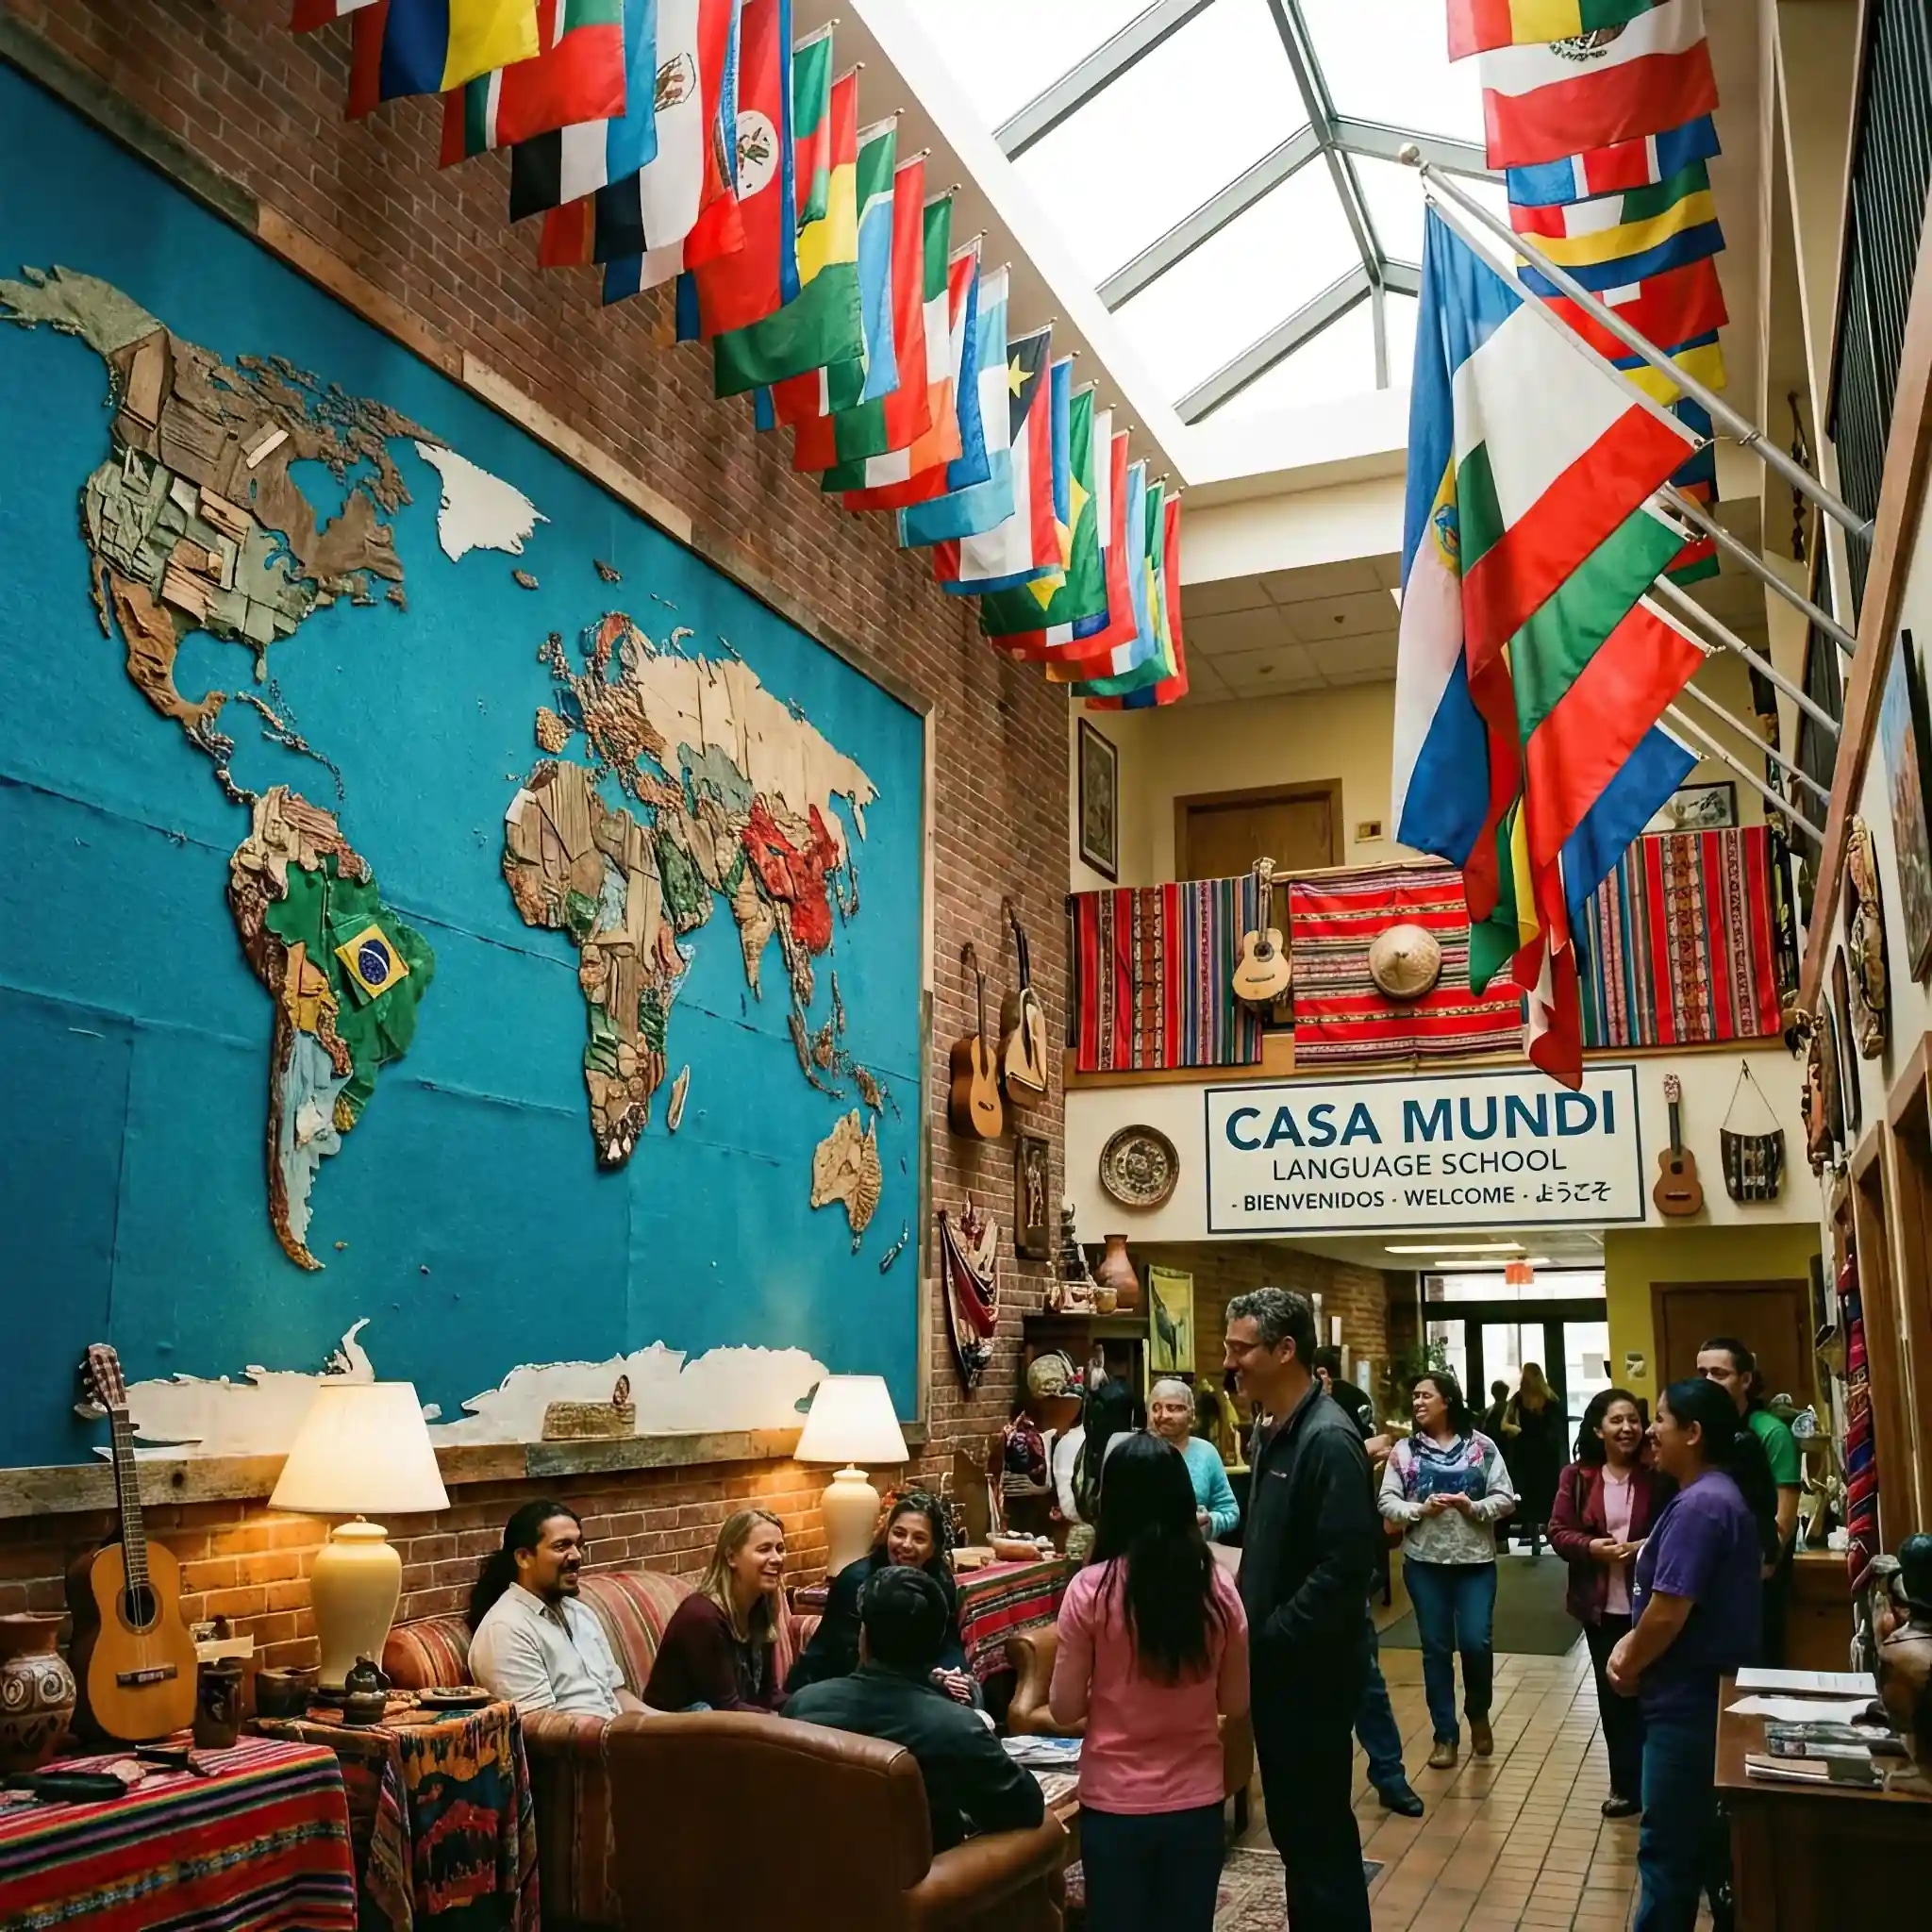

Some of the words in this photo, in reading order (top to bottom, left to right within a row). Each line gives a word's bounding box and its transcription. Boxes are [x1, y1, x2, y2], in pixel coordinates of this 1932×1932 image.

[1225, 1102, 1383, 1152] CASA
[1403, 1090, 1616, 1143] MUNDI
[1273, 1155, 1432, 1182] LANGUAGE
[1441, 1149, 1568, 1175] SCHOOL
[1243, 1191, 1385, 1213] BIENVENIDOS
[1404, 1186, 1515, 1208] WELCOME
[1535, 1181, 1612, 1205] ようこそ
